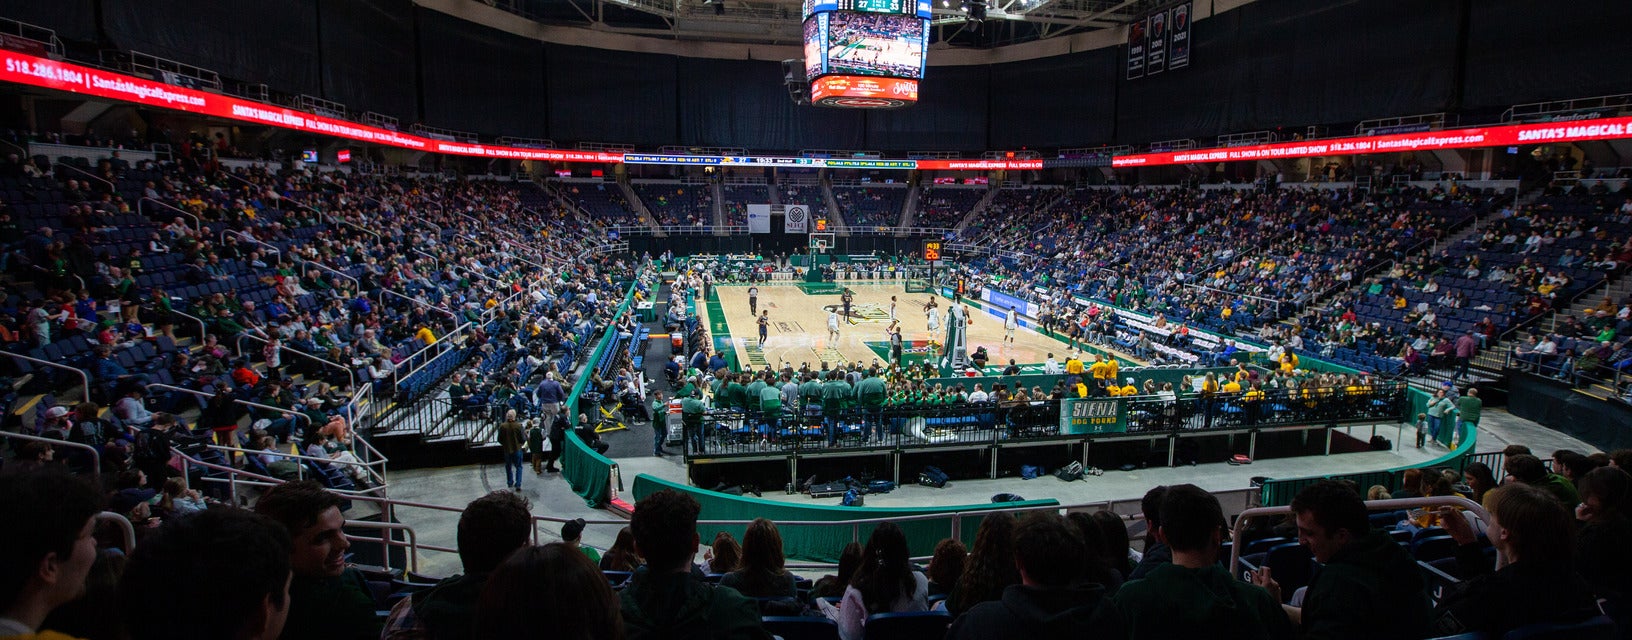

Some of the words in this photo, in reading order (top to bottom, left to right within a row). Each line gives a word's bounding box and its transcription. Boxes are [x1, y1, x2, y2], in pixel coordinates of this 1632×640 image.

[858, 0, 868, 8] 27
[889, 3, 899, 11] 33
[92, 75, 206, 107] SantasMagicalExpress.com
[1518, 128, 1566, 140] SANTA'S
[1566, 124, 1625, 137] MAGICAL
[1285, 147, 1308, 155] LIMITED
[1377, 135, 1484, 148] SantasMagicalExpress.com
[926, 249, 938, 259] 26
[1072, 401, 1117, 417] SIENA
[1091, 416, 1117, 424] POUND
[1243, 570, 1251, 583] G
[1433, 586, 1442, 598] J
